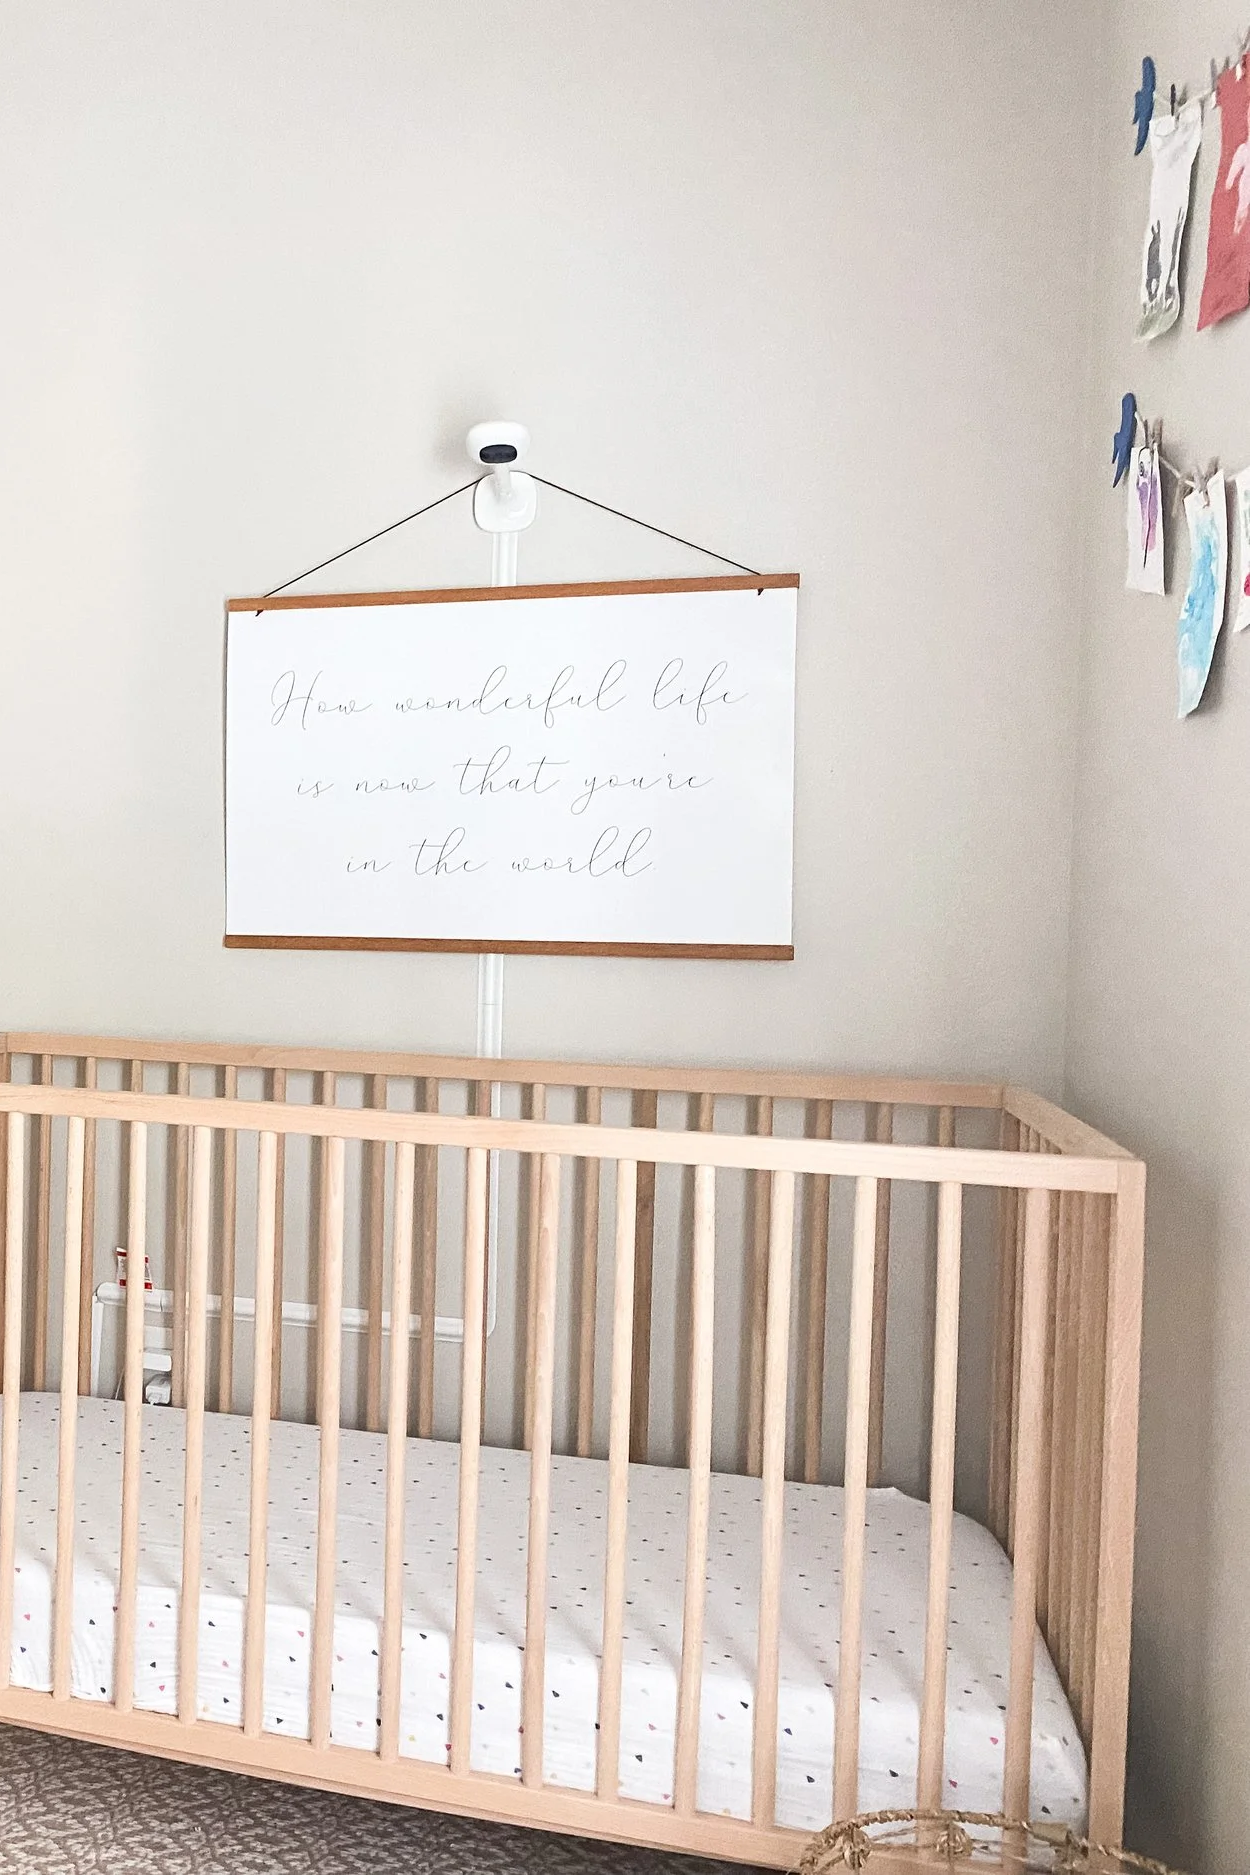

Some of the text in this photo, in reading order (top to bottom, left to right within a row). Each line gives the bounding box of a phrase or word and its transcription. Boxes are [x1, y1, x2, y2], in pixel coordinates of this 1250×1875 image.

[271, 658, 749, 730] How wonderful life
[297, 745, 714, 815] is now that you're
[347, 856, 391, 873] in
[408, 826, 488, 876] the
